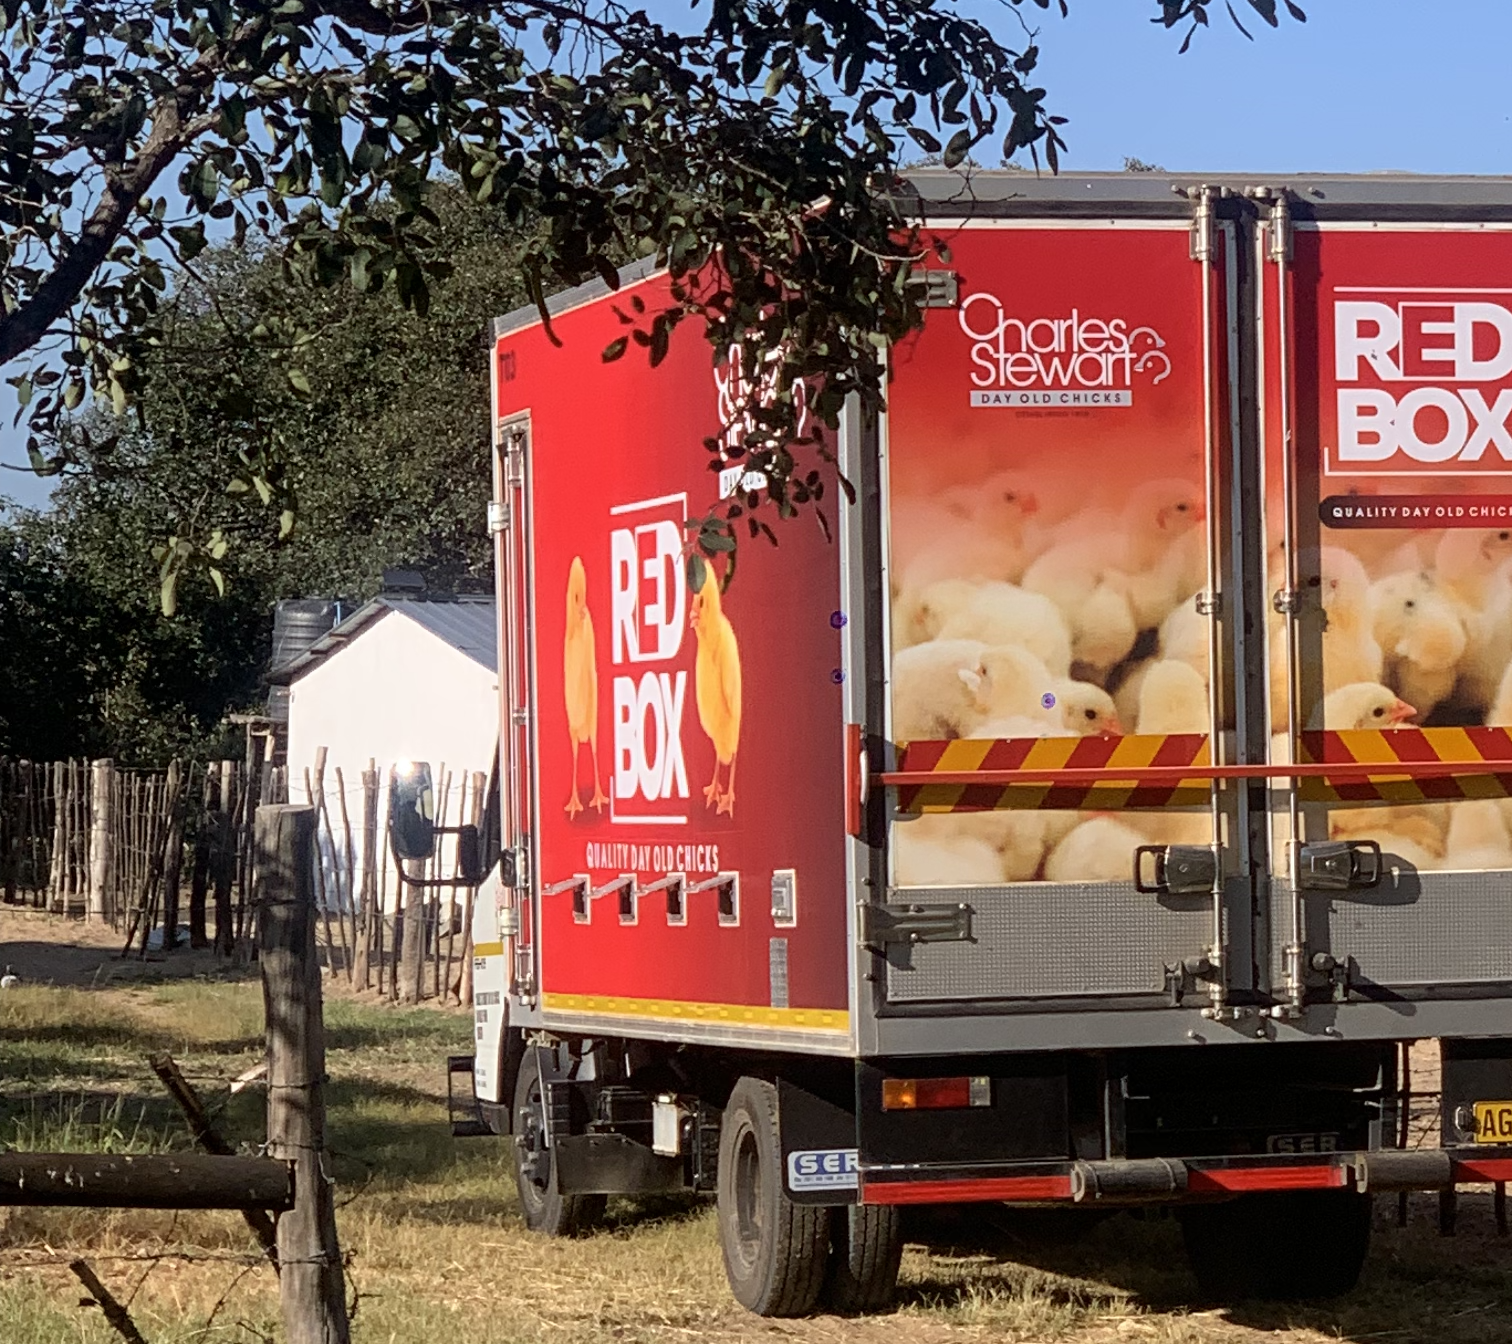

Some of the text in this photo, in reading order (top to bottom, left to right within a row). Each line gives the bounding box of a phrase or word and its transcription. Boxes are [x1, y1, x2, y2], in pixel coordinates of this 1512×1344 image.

[959, 292, 1128, 353] Charles
[970, 342, 1138, 387] Stewart
[981, 392, 1122, 404] DAY OLD CHICKS
[1332, 507, 1397, 519] QUALITY
[1402, 507, 1431, 517] DAY
[1435, 507, 1464, 517] OLD
[610, 520, 687, 664] RED
[613, 671, 690, 801] BOX
[586, 841, 719, 873] QUALITY DAY OLD CHICKS
